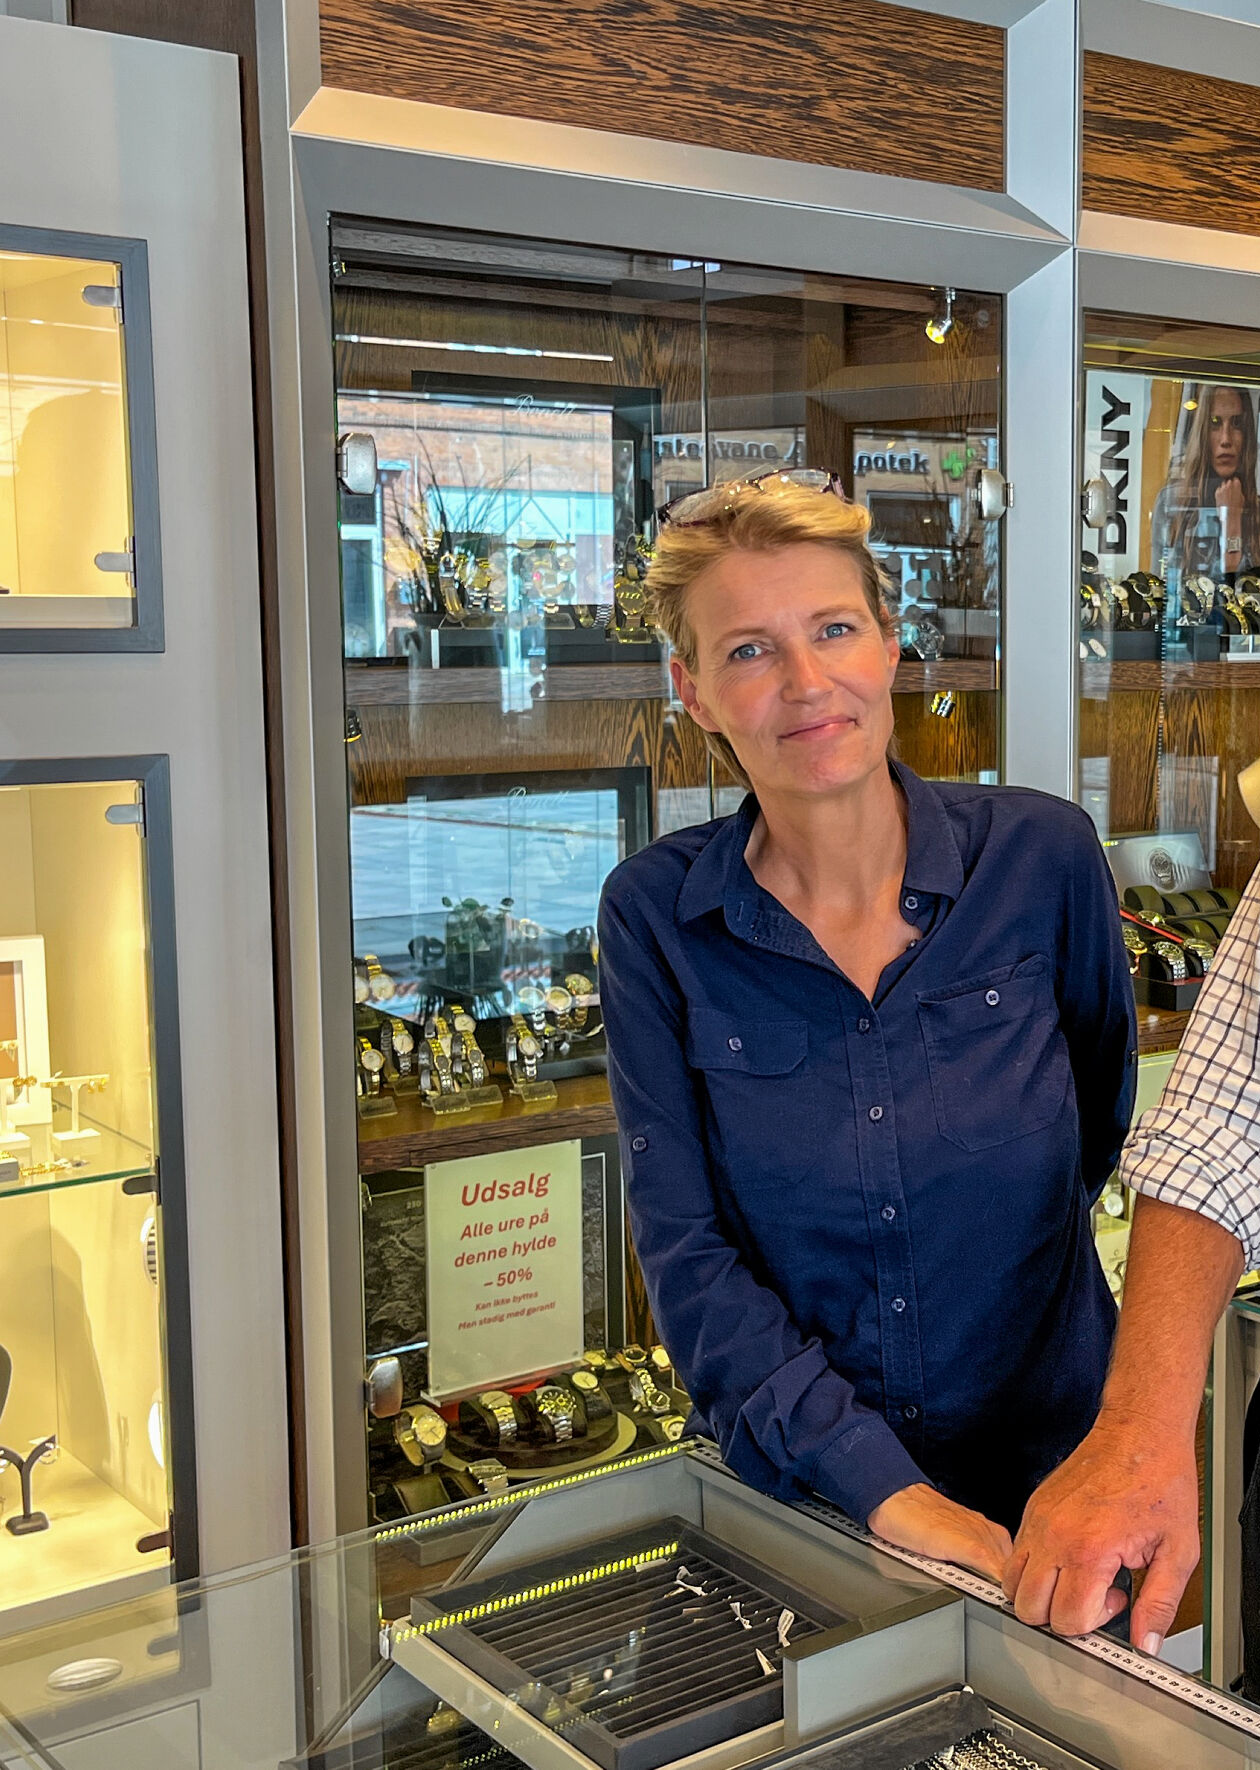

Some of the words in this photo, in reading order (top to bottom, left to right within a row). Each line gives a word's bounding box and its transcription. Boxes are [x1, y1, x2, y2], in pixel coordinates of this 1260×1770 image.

[1098, 384, 1131, 554] DKNY
[461, 1172, 551, 1206] Udsalg
[460, 1221, 494, 1241] Alle
[498, 1217, 525, 1233] ure
[528, 1207, 549, 1230] på
[454, 1247, 508, 1268] denne
[512, 1235, 556, 1257] hylde
[496, 1266, 533, 1287] 50%
[475, 1302, 491, 1312] Kan
[493, 1297, 511, 1307] ikke
[513, 1291, 538, 1304] byttes
[458, 1320, 477, 1331] Men
[506, 1308, 526, 1319] med
